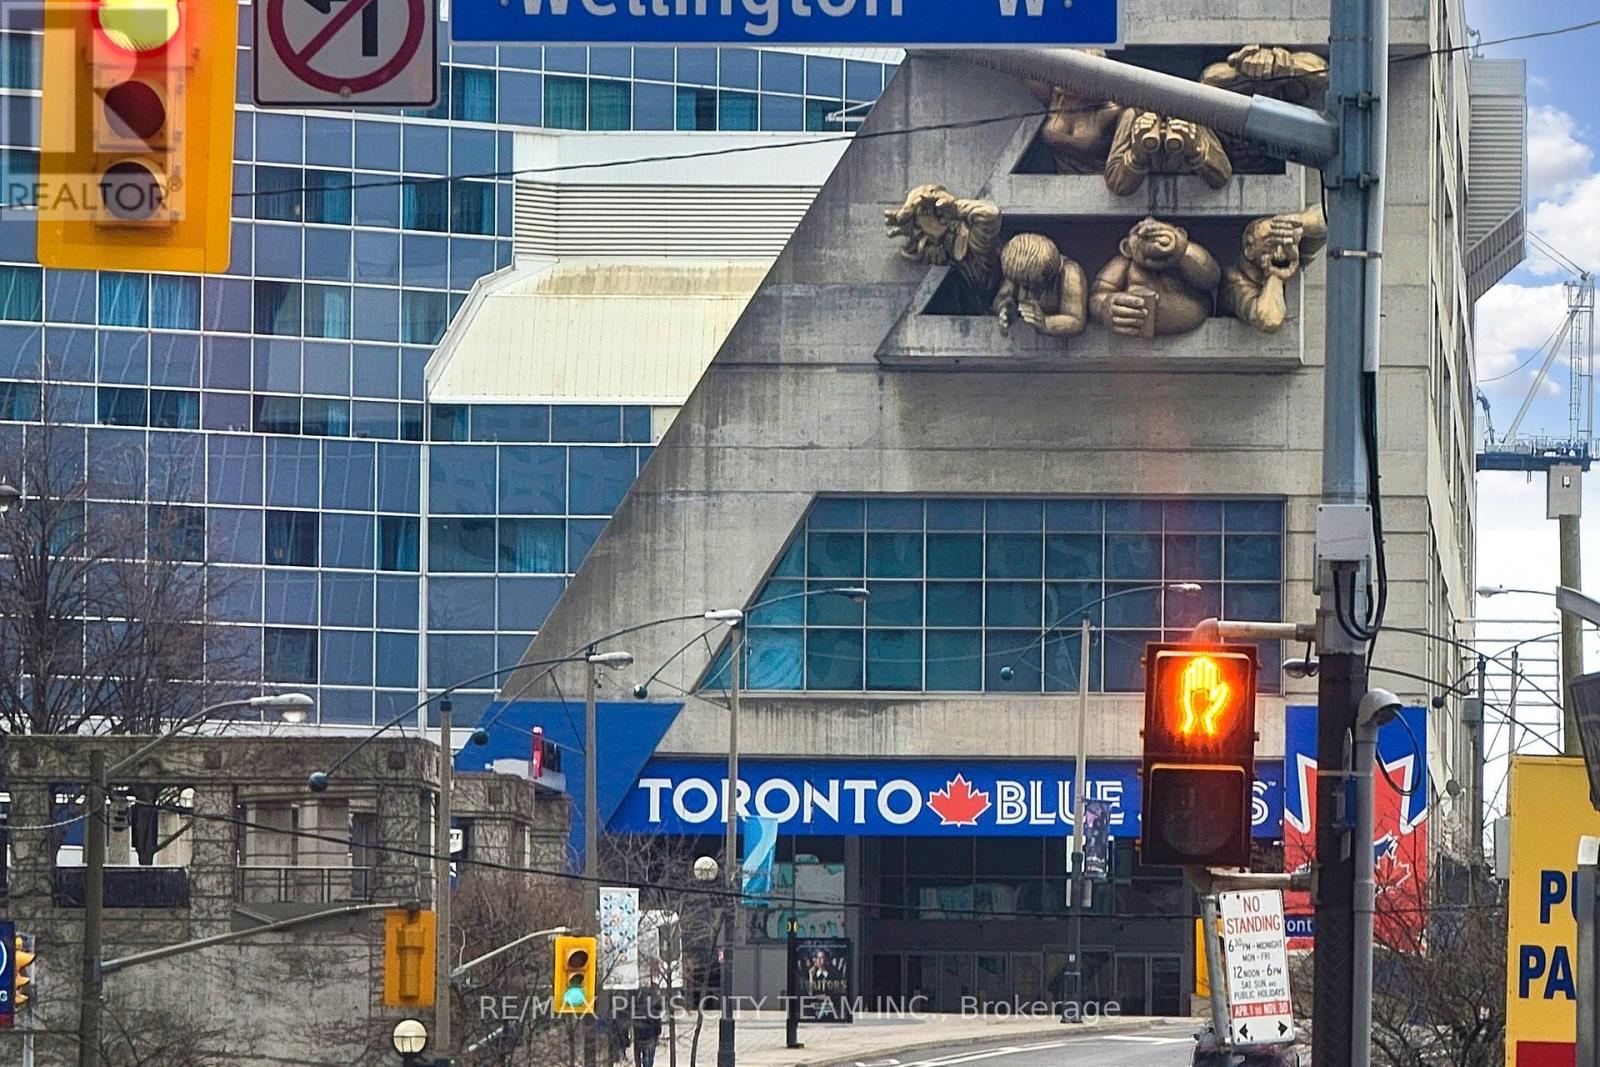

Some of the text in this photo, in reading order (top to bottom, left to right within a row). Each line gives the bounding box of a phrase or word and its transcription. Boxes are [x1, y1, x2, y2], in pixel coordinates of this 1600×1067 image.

[638, 778, 923, 824] TORONTO
[1243, 895, 1260, 913] NO
[1226, 914, 1281, 935] STANDING
[1256, 939, 1282, 950] MIDNIGHT
[1242, 953, 1256, 962] MON
[1234, 988, 1285, 1000] PUBLIC HOLIDAYS
